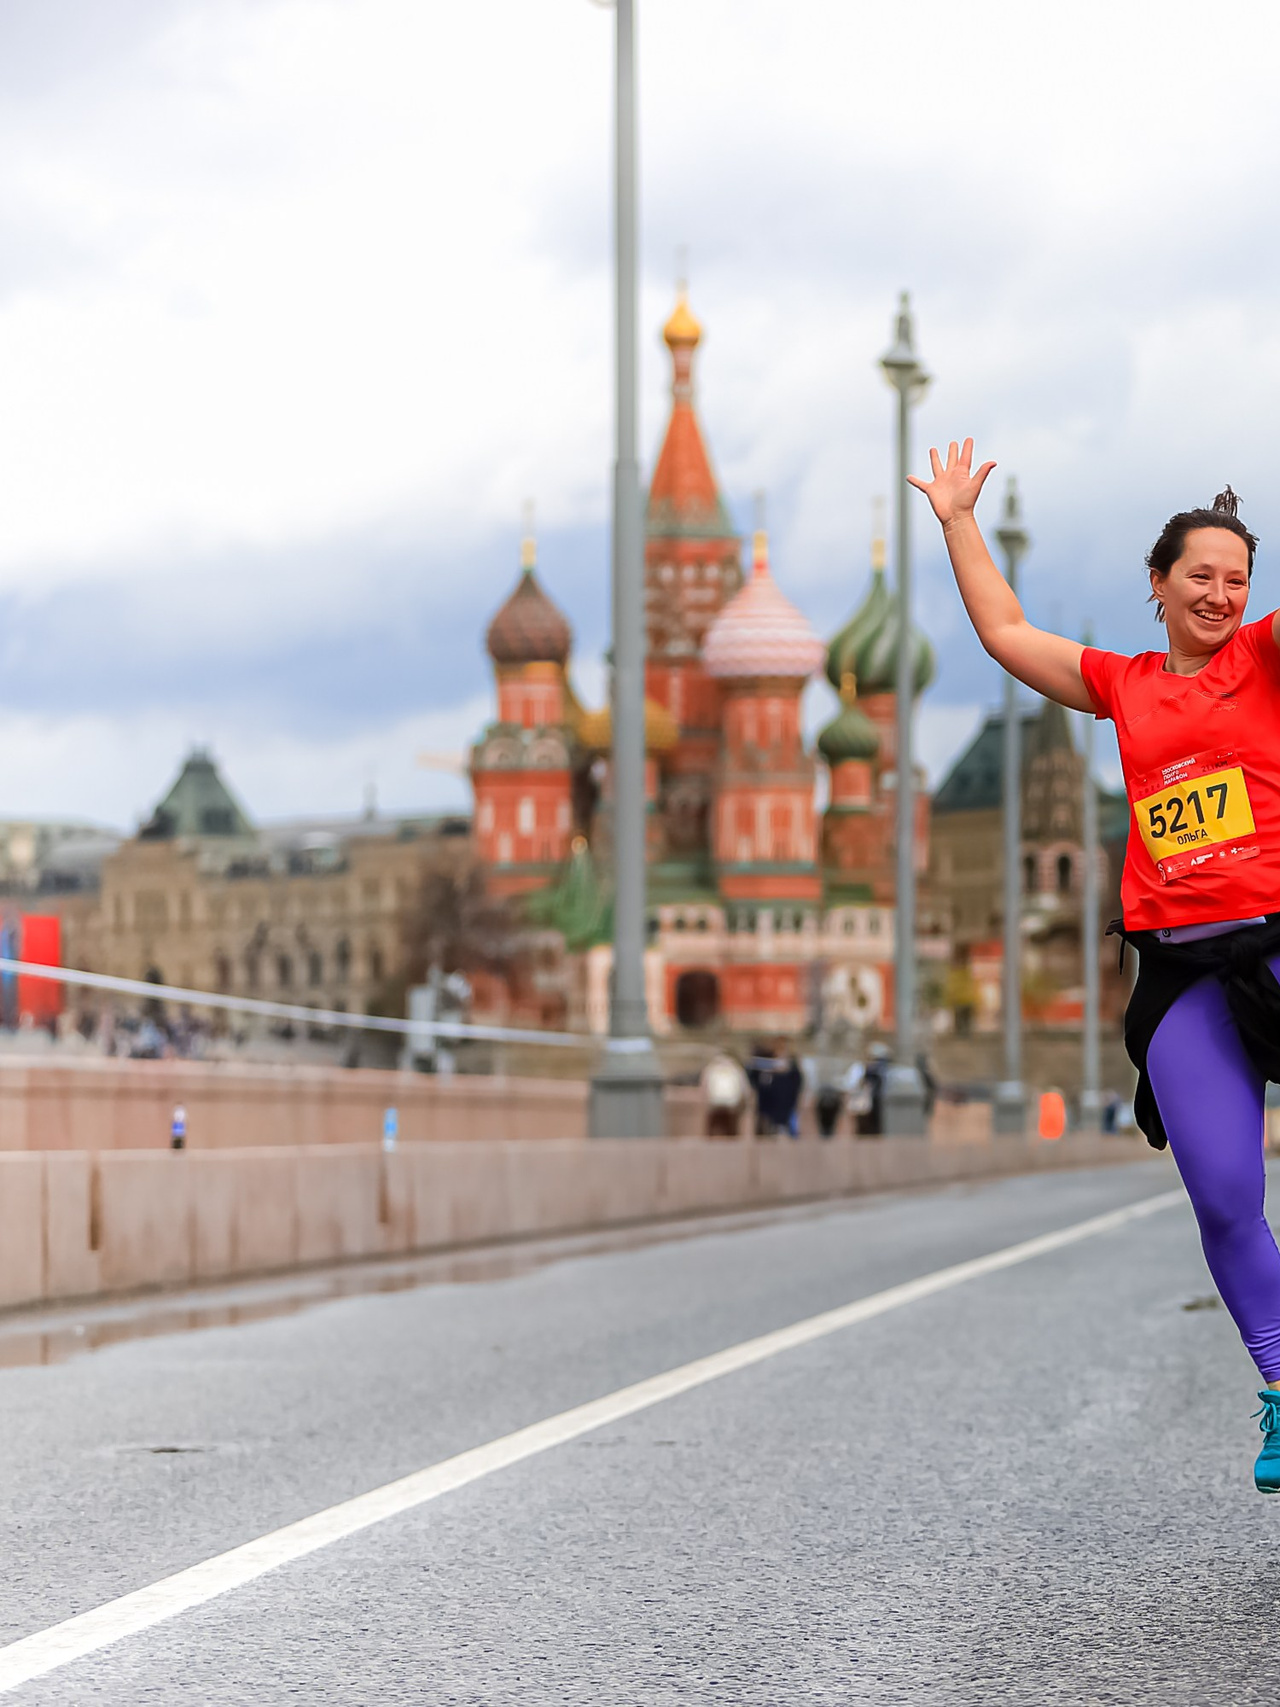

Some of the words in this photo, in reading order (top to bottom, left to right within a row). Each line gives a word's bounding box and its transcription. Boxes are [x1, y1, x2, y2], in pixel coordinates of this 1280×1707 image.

[1161, 757, 1196, 775] МОСКОВСКИЙ
[1149, 783, 1228, 839] 5217
[1177, 828, 1208, 845] ОЛЬГА
